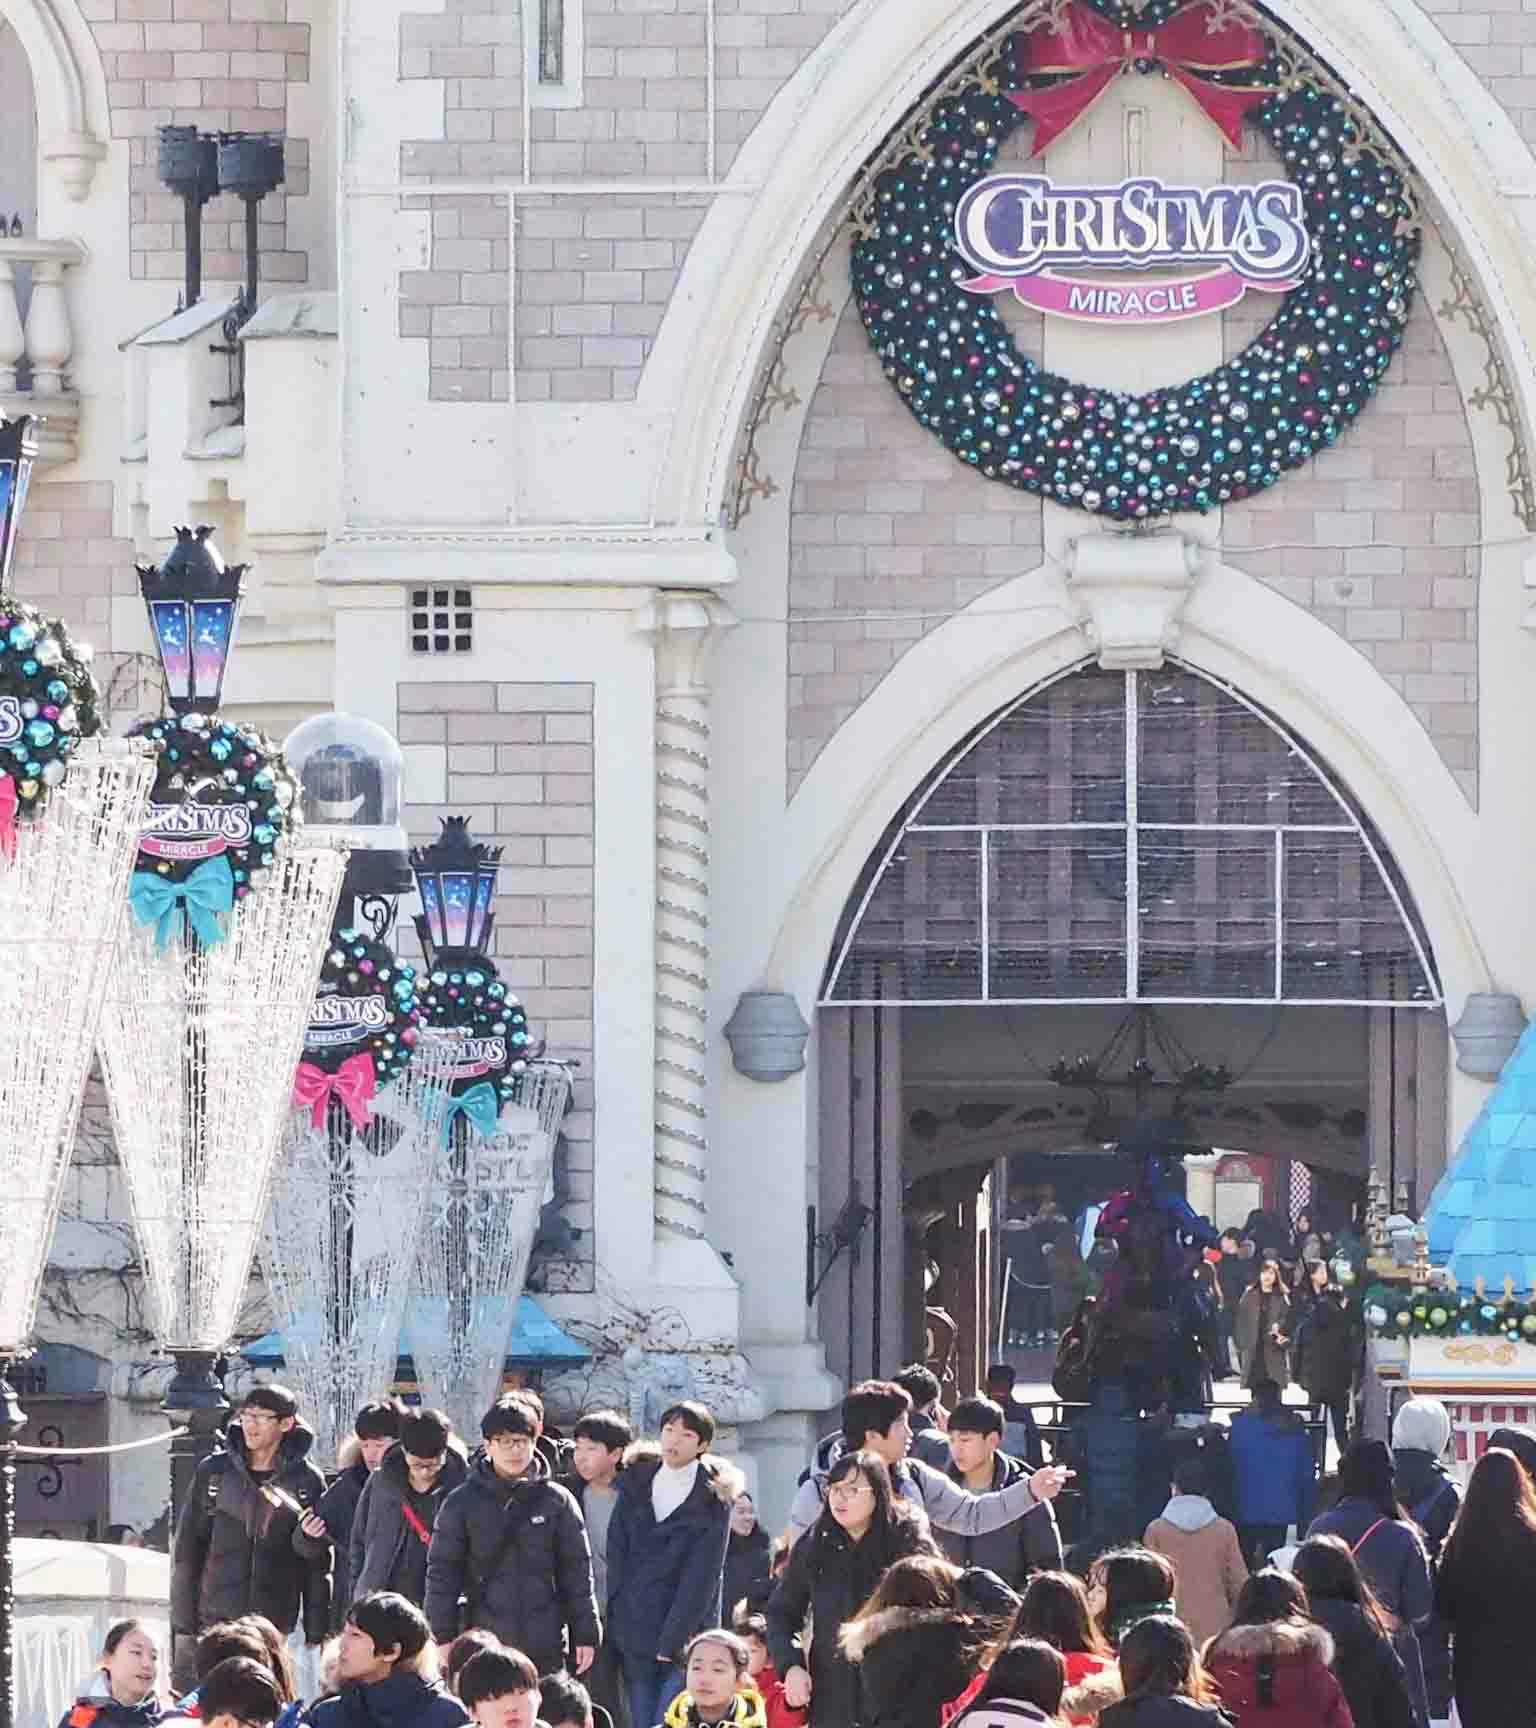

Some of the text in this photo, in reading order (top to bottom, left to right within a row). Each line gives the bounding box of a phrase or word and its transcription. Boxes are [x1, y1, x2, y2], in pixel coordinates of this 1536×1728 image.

[965, 182, 1299, 270] CHRISTMAS
[1068, 285, 1198, 316] MIRACLE
[159, 843, 209, 857] MIRACLE
